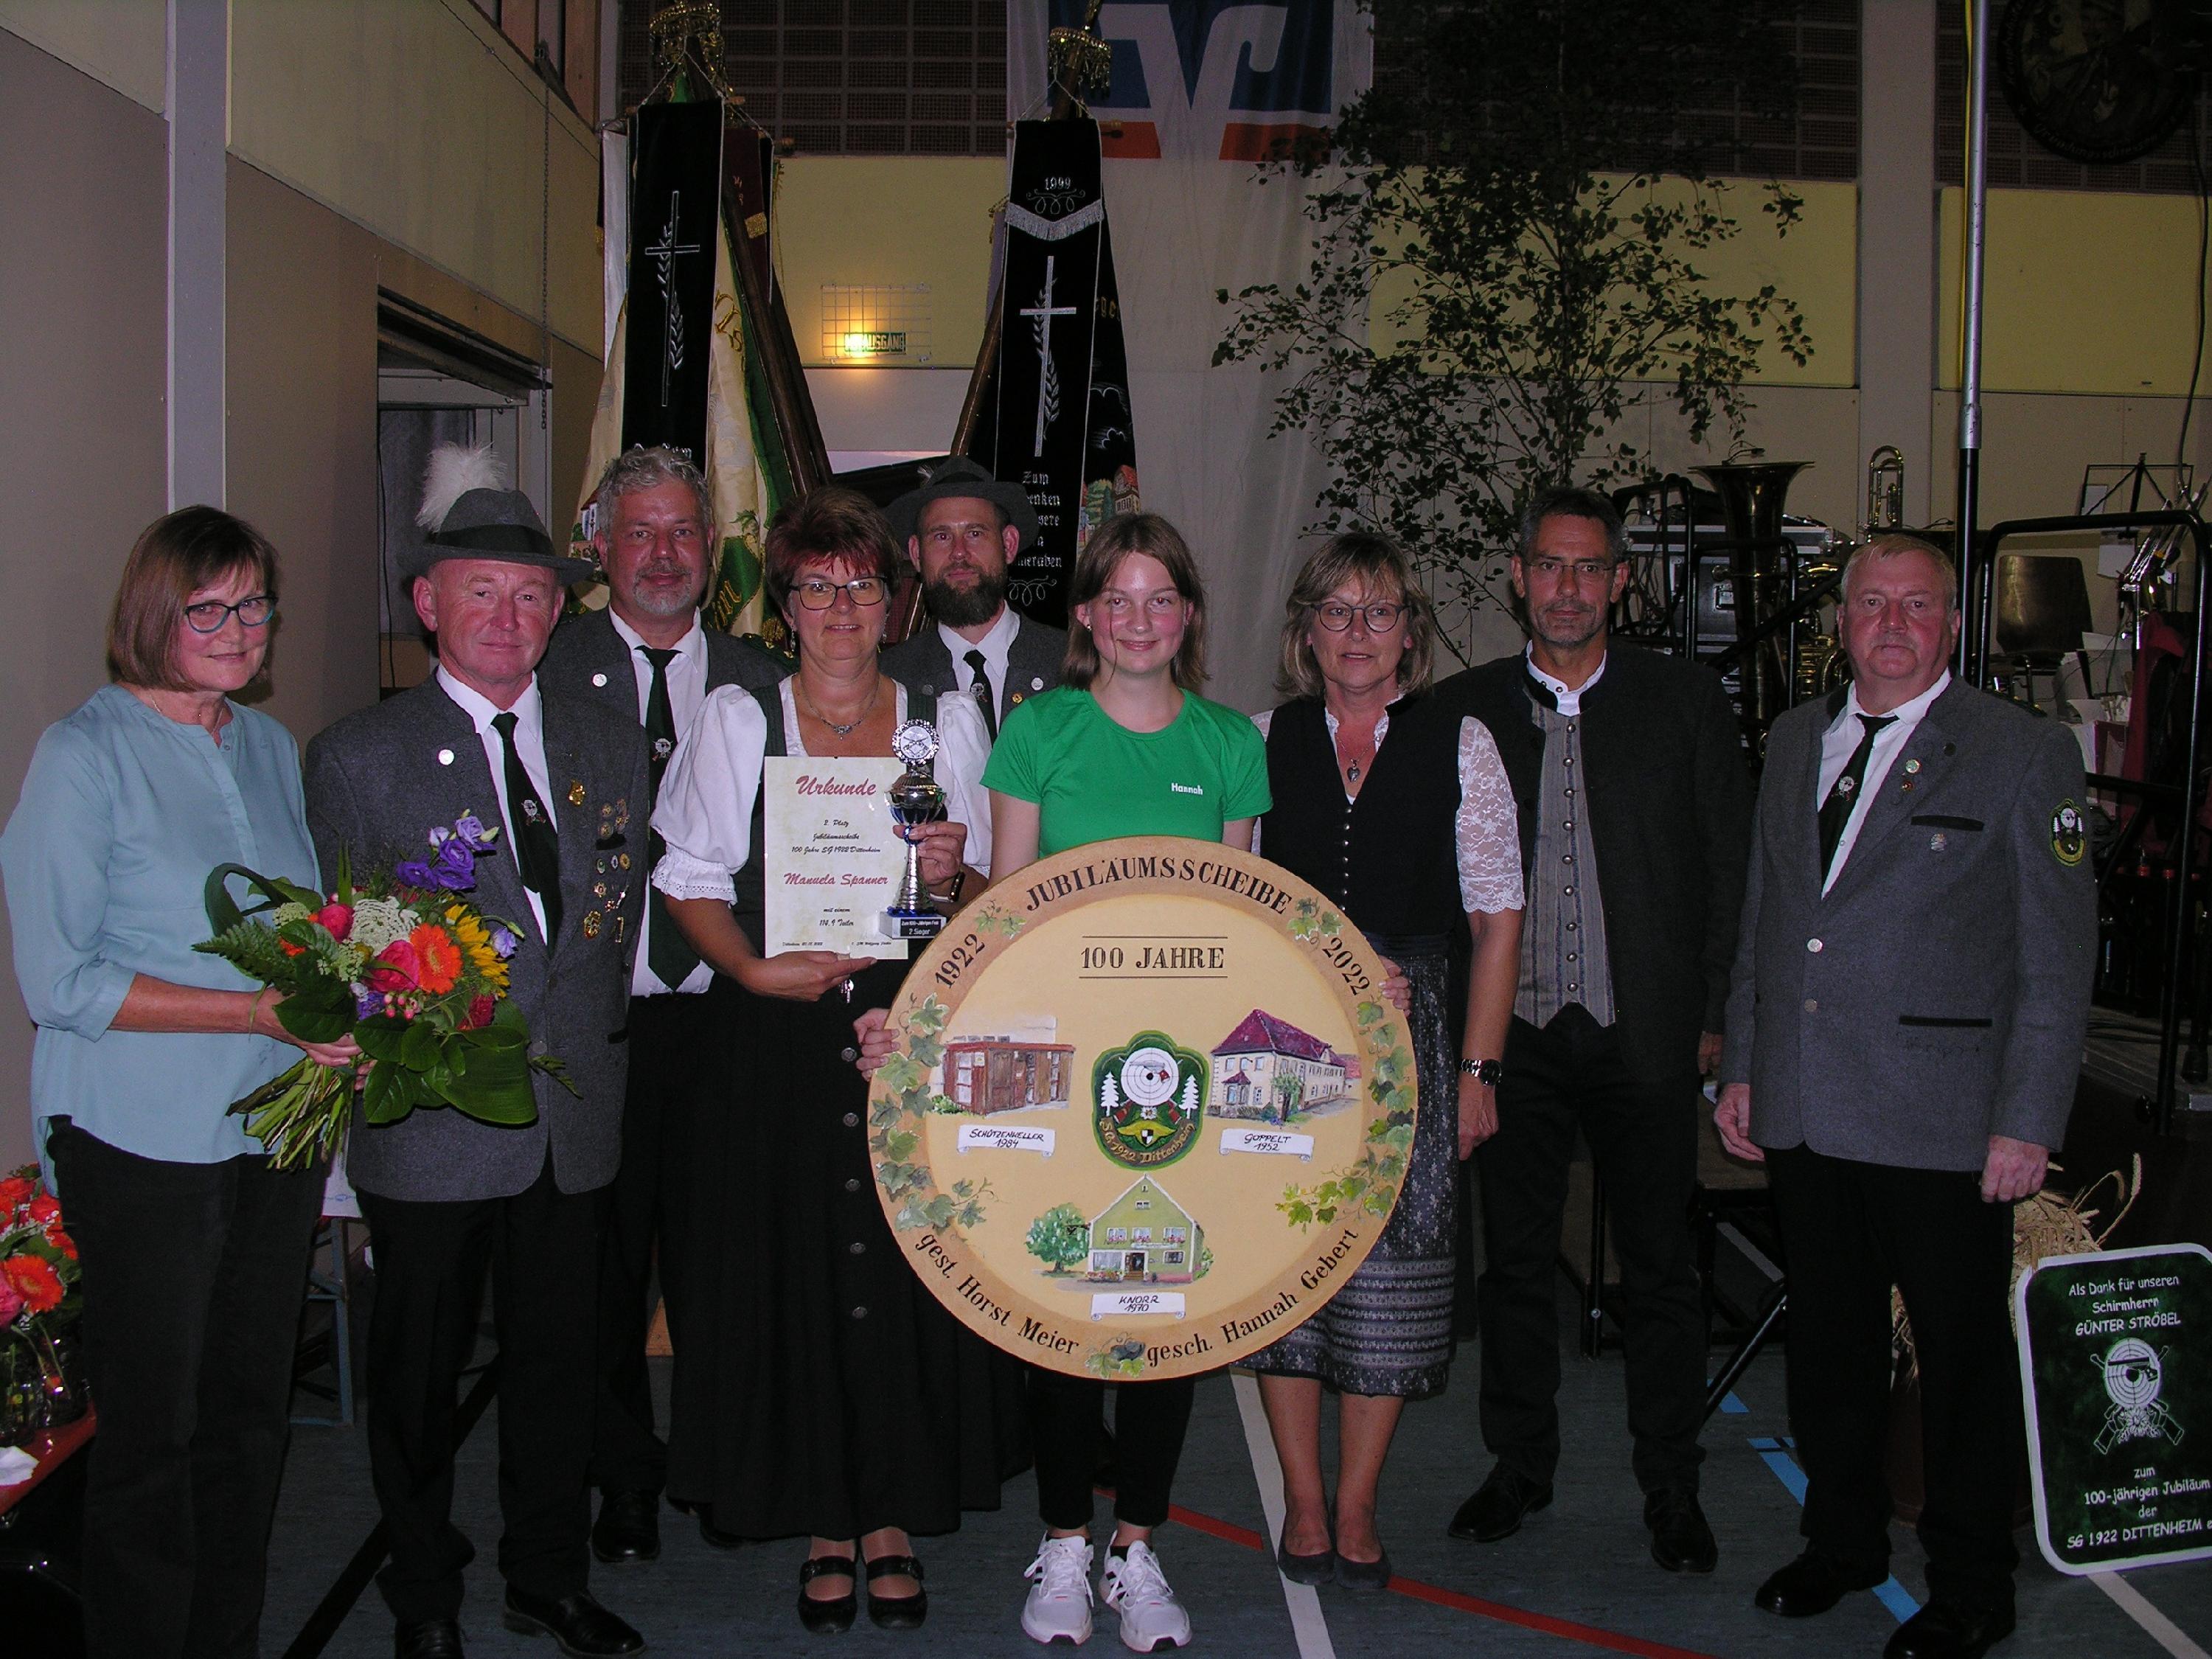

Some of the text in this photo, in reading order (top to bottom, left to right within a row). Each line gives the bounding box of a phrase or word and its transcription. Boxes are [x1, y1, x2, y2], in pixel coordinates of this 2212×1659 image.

[1044, 176, 1071, 191] 1999
[844, 334, 905, 351] NAUSGANG
[1022, 470, 1050, 485] Zum
[795, 775, 877, 796] Urkunde
[1171, 782, 1203, 796] Hannah
[832, 819, 849, 828] Platz
[813, 832, 860, 842] Jubiläumsscheibe
[804, 846, 820, 856] Jahre
[821, 846, 834, 855] SG
[783, 872, 888, 888] Manuela Spanner
[1026, 856, 1293, 915] JUBILÄUMSSCHEIBE
[935, 933, 985, 989] 1922
[1080, 947, 1225, 969] 100 JAHRE
[1321, 937, 1371, 996] 2022
[969, 1128, 1044, 1142] SCHÜTZENKELLER
[1244, 1133, 1291, 1144] GOPPELT
[992, 1138, 1019, 1149] 1984
[1110, 1142, 1136, 1162] 1922
[1139, 1123, 1196, 1164] Dittenheim
[1253, 1142, 1279, 1152] 1952
[915, 1234, 1079, 1354] gest. Horst Meier
[2068, 1276, 2180, 1296] Als Dank für unseren
[1118, 1295, 1161, 1304] KNORR
[1147, 1228, 1359, 1367] gesch. Hannah Gebert
[2091, 1296, 2160, 1314] Schirmherrn
[1124, 1303, 1150, 1312] 1970
[2075, 1311, 2182, 1337] GÜNTER STRÖBEL
[2133, 1467, 2156, 1479] zum
[2084, 1478, 2211, 1506] 100-jährigen Jubiläum
[2138, 1504, 2158, 1519] der
[2067, 1534, 2084, 1549] SG
[2089, 1528, 2118, 1546] 1922
[2122, 1517, 2202, 1542] DITTENHEIM
